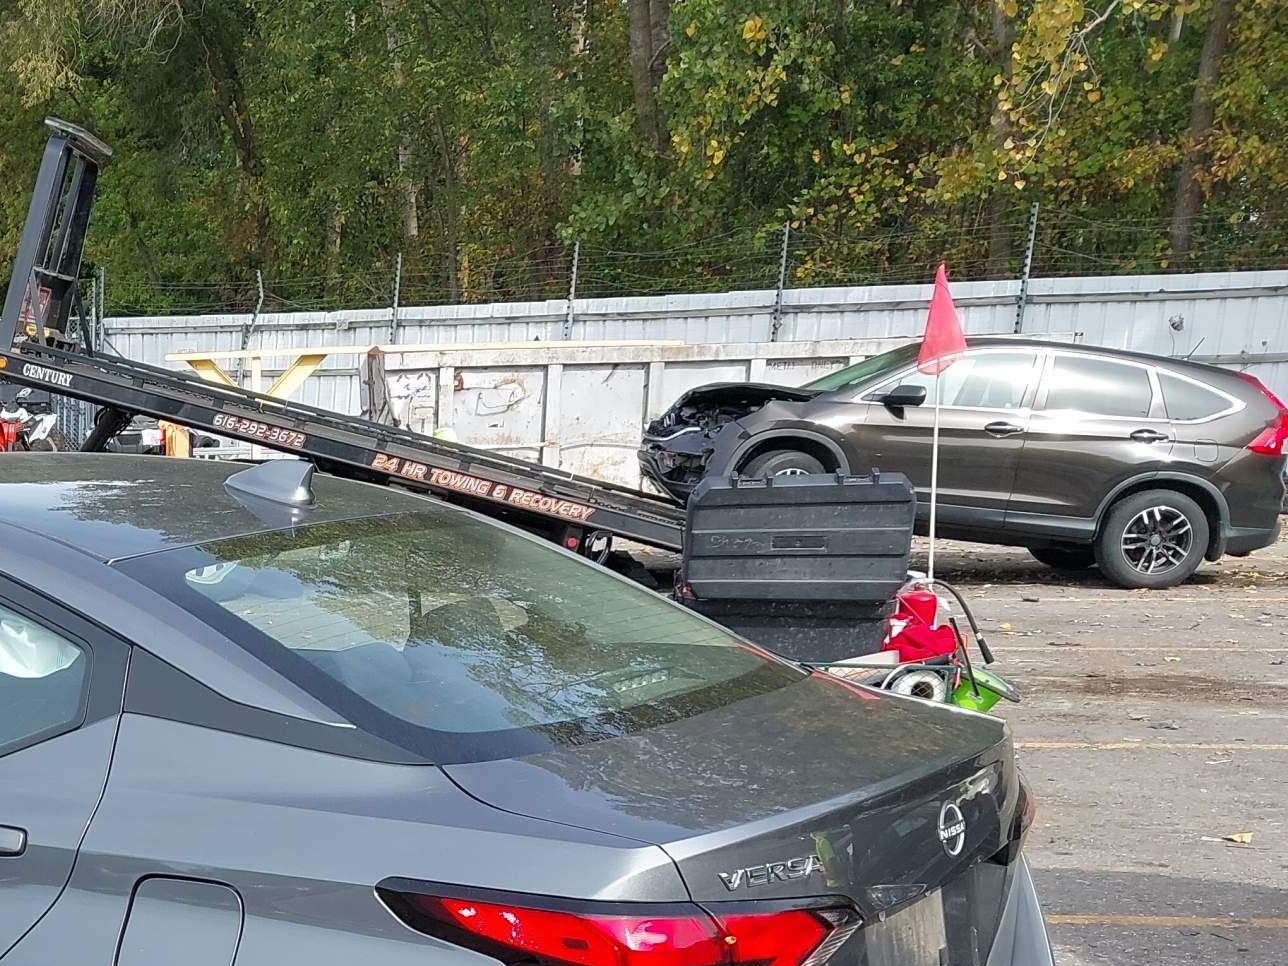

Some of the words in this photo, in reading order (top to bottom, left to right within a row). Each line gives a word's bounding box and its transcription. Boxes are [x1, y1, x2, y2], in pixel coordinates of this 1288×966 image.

[22, 363, 73, 387] CENTURY
[213, 414, 306, 448] 616-292-3672
[371, 453, 400, 472] 24
[401, 460, 427, 480] HR
[430, 468, 492, 494] TOWING
[492, 484, 508, 500] &
[509, 489, 595, 520] RECOVERY
[940, 821, 965, 840] NISSA
[717, 854, 825, 891] VERSA
